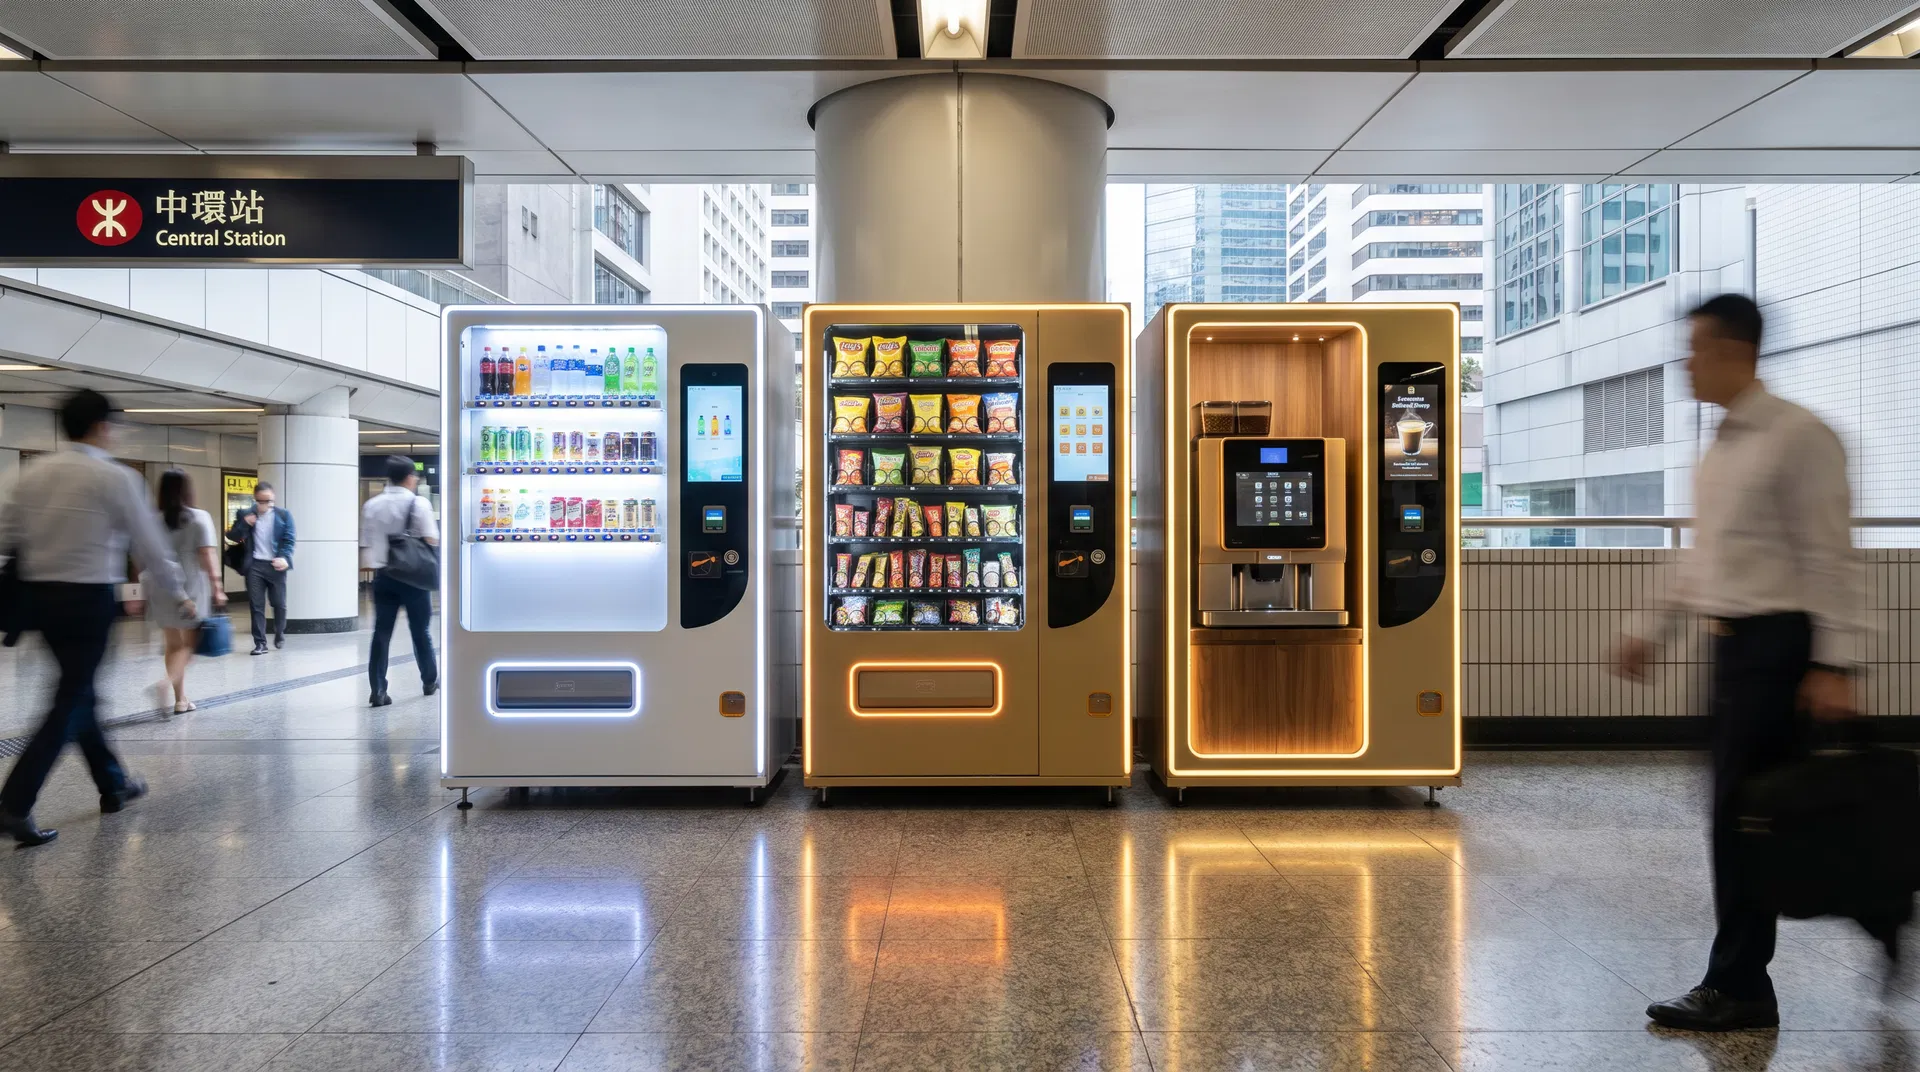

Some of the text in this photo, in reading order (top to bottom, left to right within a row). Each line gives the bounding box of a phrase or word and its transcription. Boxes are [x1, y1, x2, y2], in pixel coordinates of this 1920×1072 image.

[156, 189, 264, 225] 中環站
[156, 229, 286, 247] Central Station
